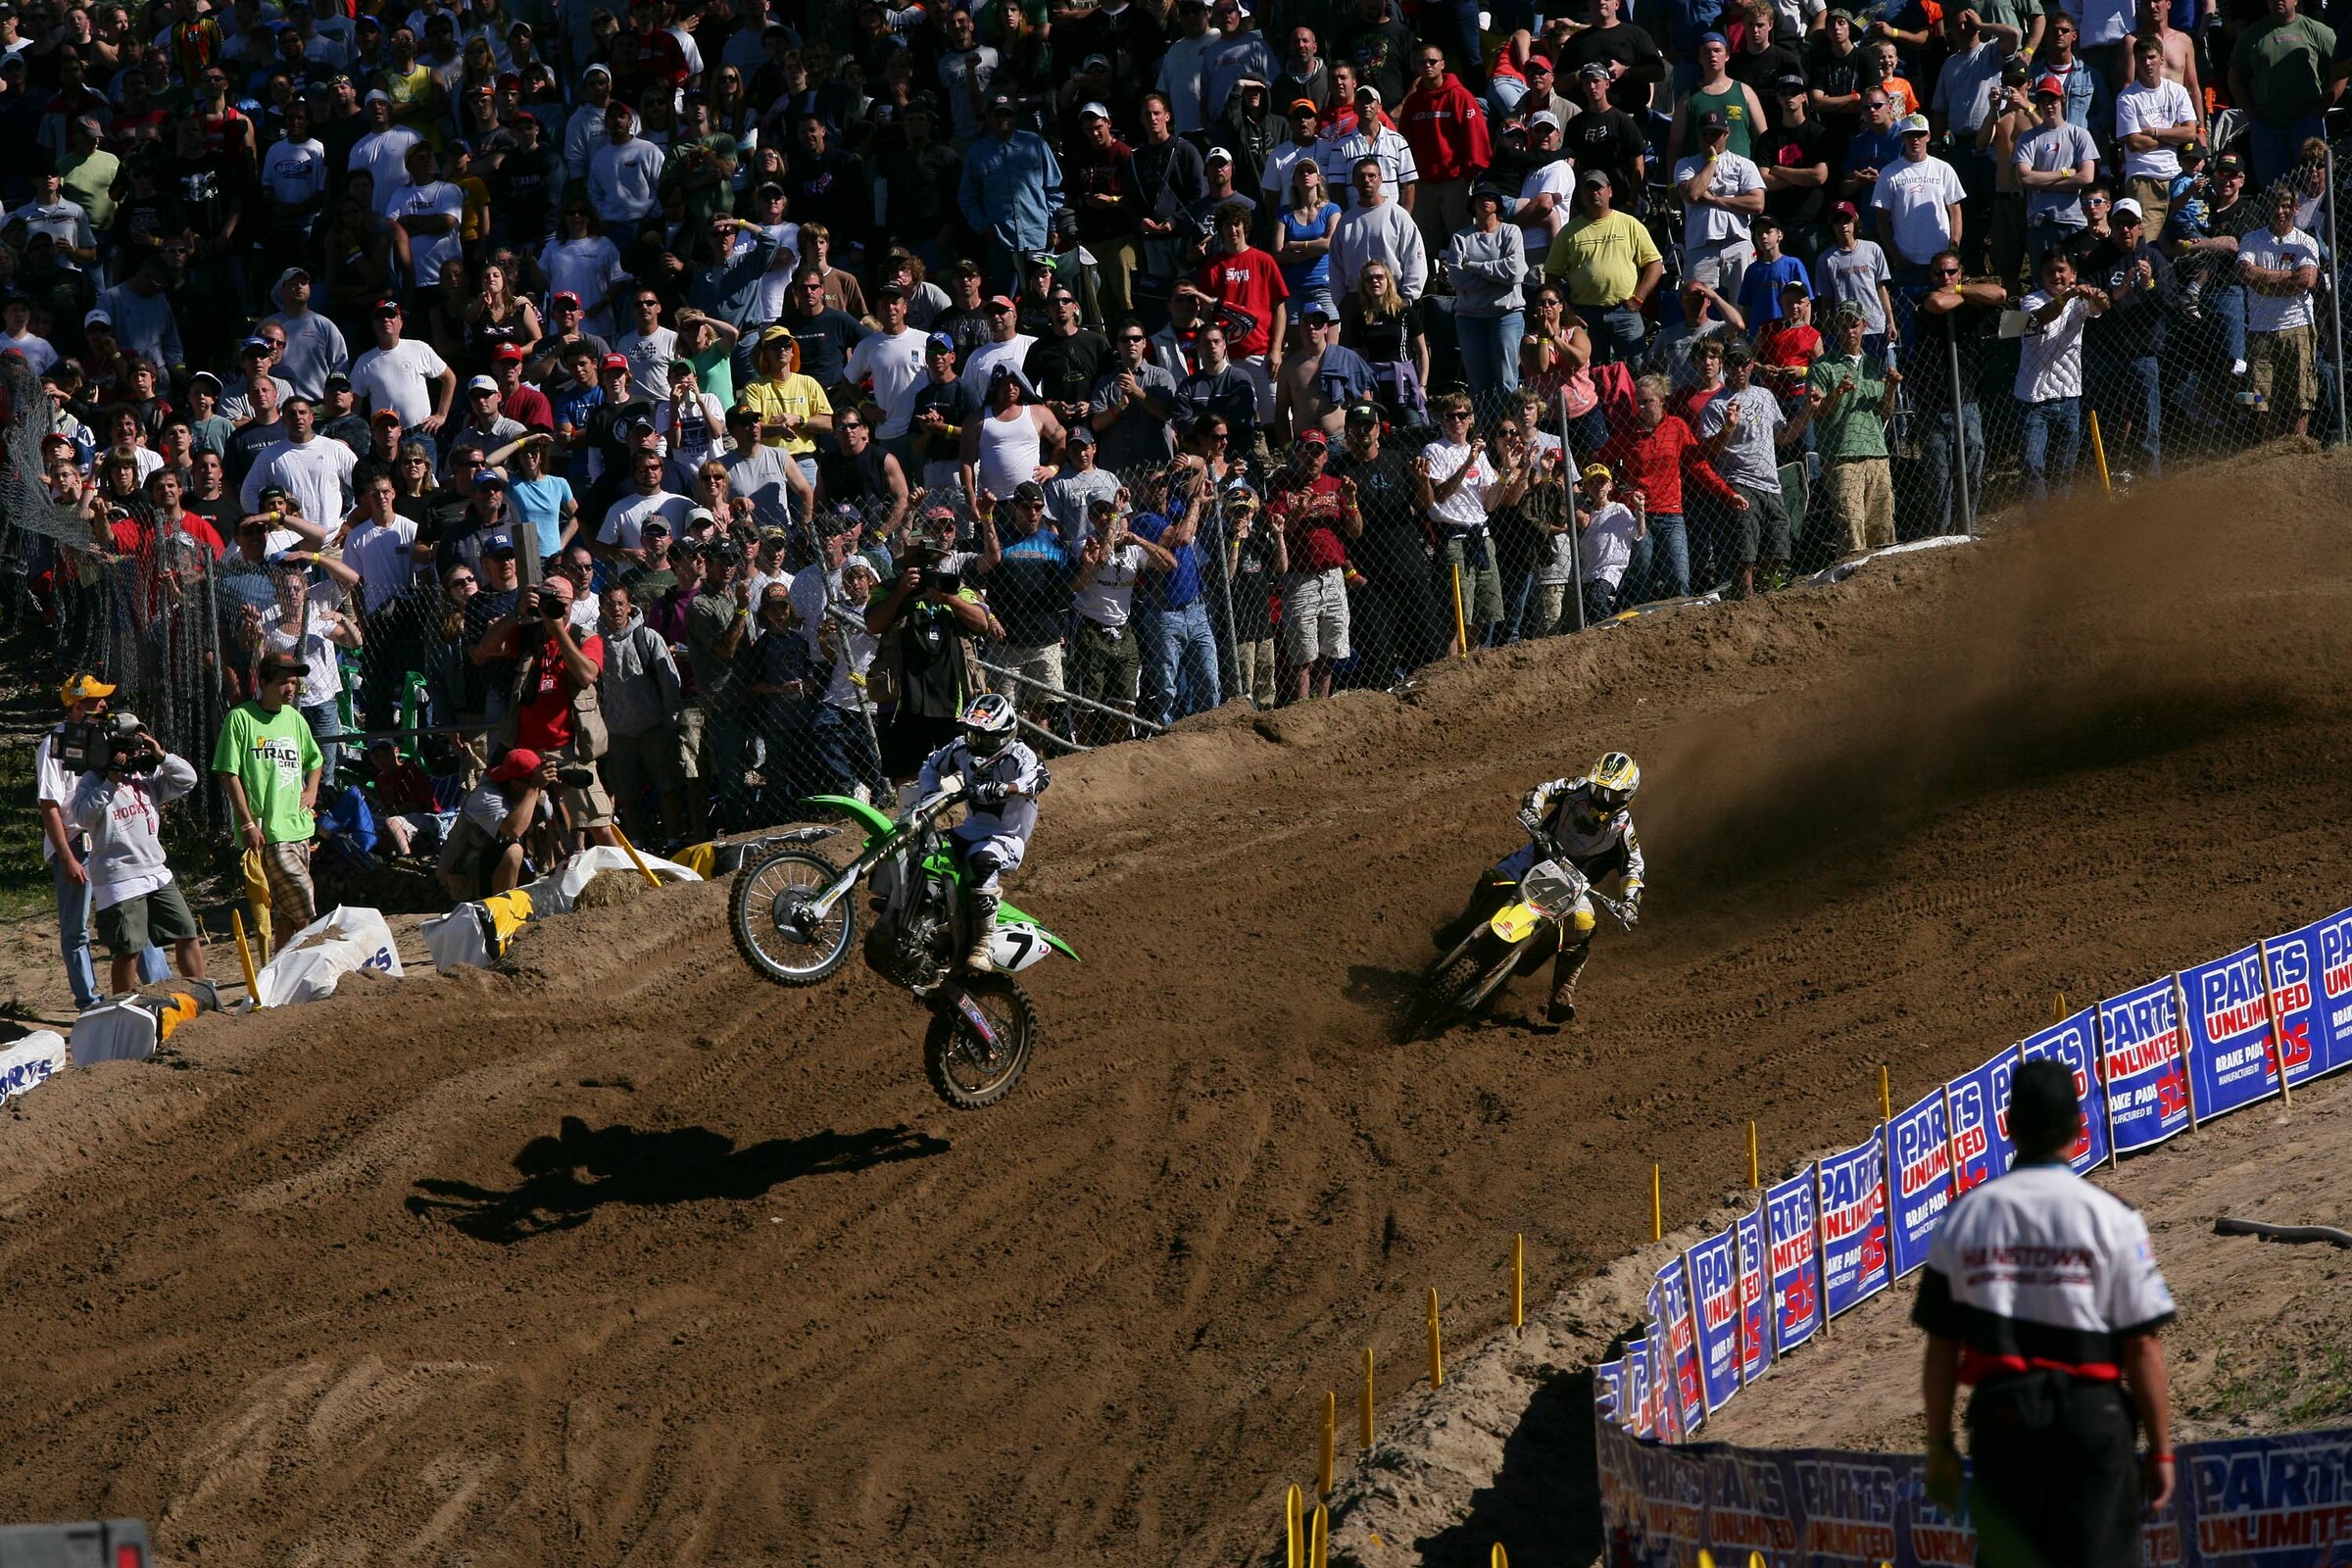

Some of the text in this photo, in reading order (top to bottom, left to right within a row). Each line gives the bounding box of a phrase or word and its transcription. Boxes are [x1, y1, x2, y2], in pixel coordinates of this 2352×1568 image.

[1226, 268, 1250, 284] Spy
[251, 747, 299, 760] TRAC
[1005, 932, 1033, 969] 7
[2206, 982, 2311, 1042] UNLIMTED
[2216, 1048, 2244, 1073] BRAKE
[2245, 1040, 2264, 1062] PADS
[0, 1058, 54, 1102] RTS
[2109, 1091, 2132, 1113] RAKE
[2134, 1083, 2158, 1105] PADS
[1902, 1125, 1987, 1198] UNLIMTED
[1768, 1184, 1813, 1245] RTS
[1929, 1190, 1948, 1215] PADS
[1773, 1230, 1814, 1274] MITED
[1827, 1253, 1843, 1276] AKE
[1797, 1460, 1895, 1526] PARTS
[2197, 1506, 2352, 1560] UNLIMITE
